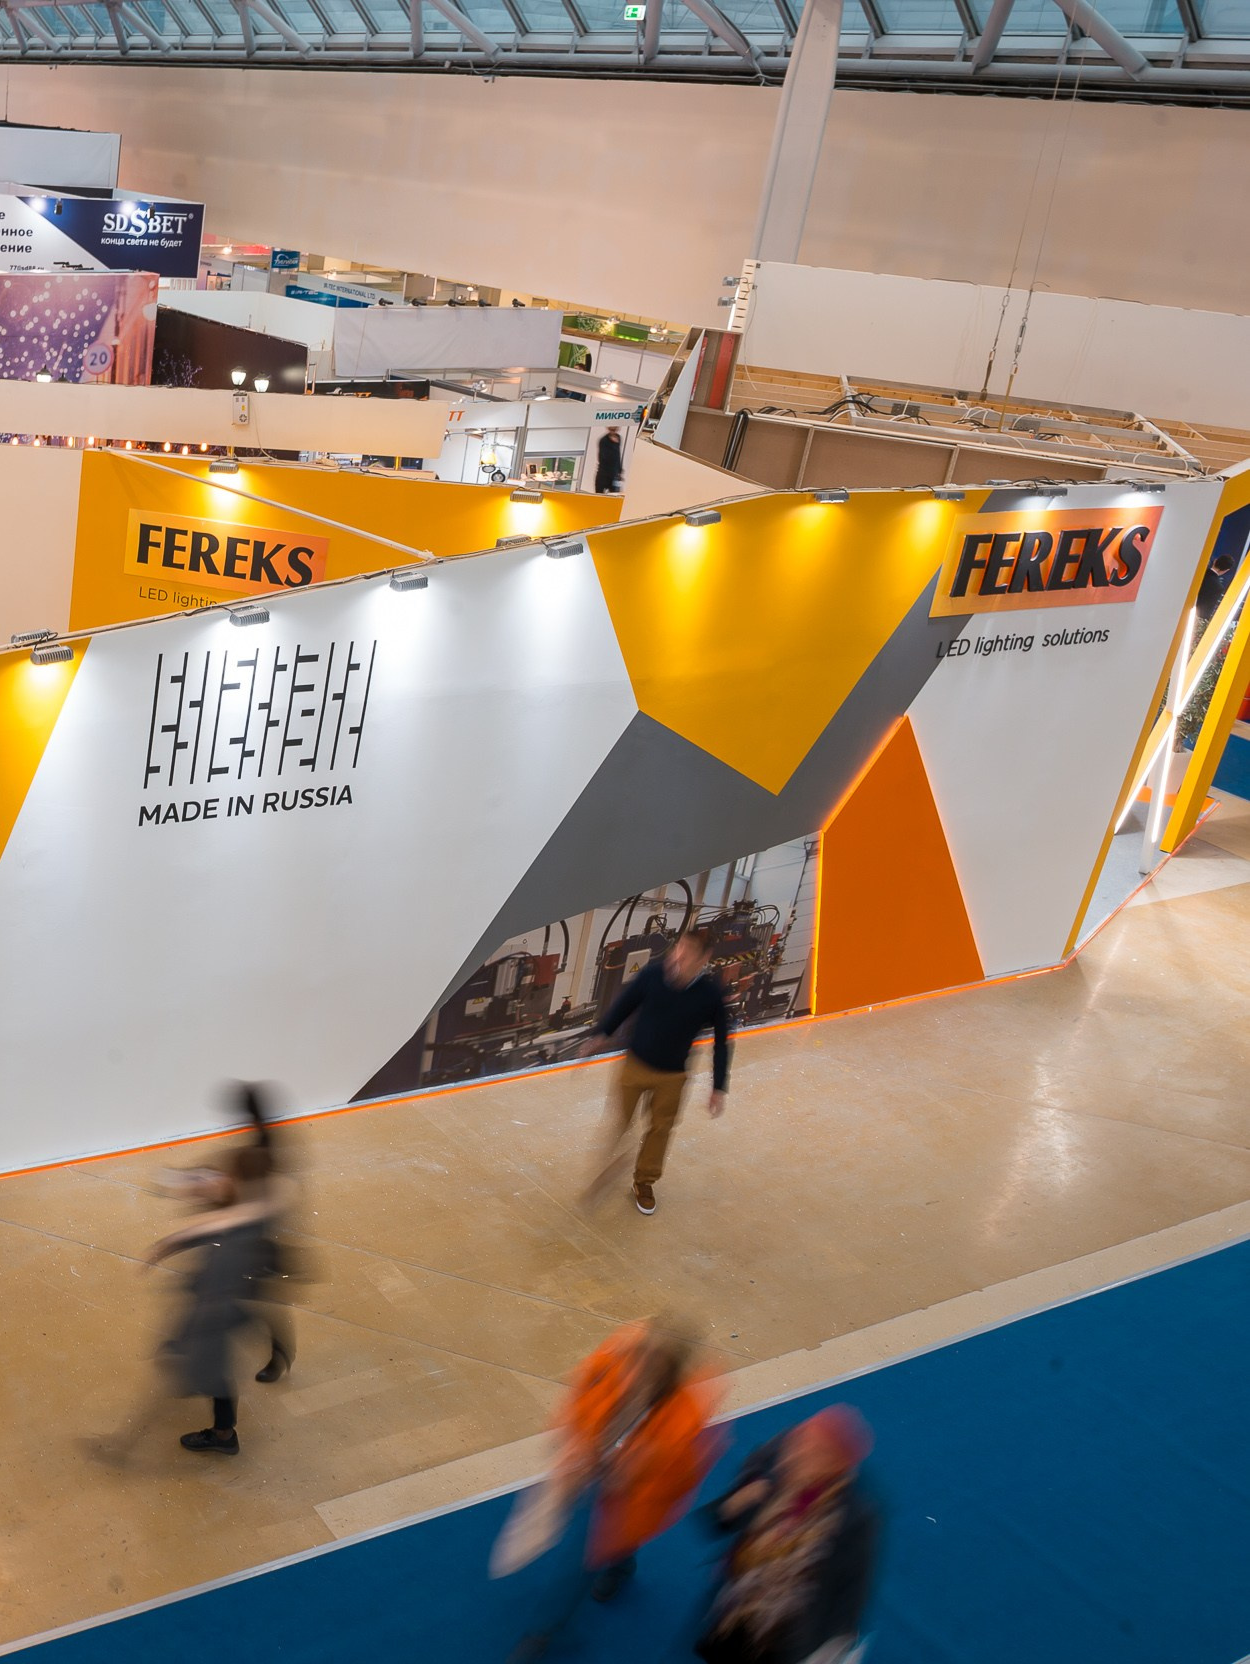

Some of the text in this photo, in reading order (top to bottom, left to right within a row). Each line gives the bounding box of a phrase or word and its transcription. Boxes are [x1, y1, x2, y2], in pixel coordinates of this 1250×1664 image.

[100, 237, 183, 248] конца света не будет
[89, 351, 108, 366] 20
[136, 522, 316, 588] FEREKS
[949, 524, 1151, 598] FEREKS
[139, 586, 218, 608] LED lightin
[935, 627, 1110, 659] LED lighting solutions
[138, 784, 353, 827] MADE IN RUSSIA
